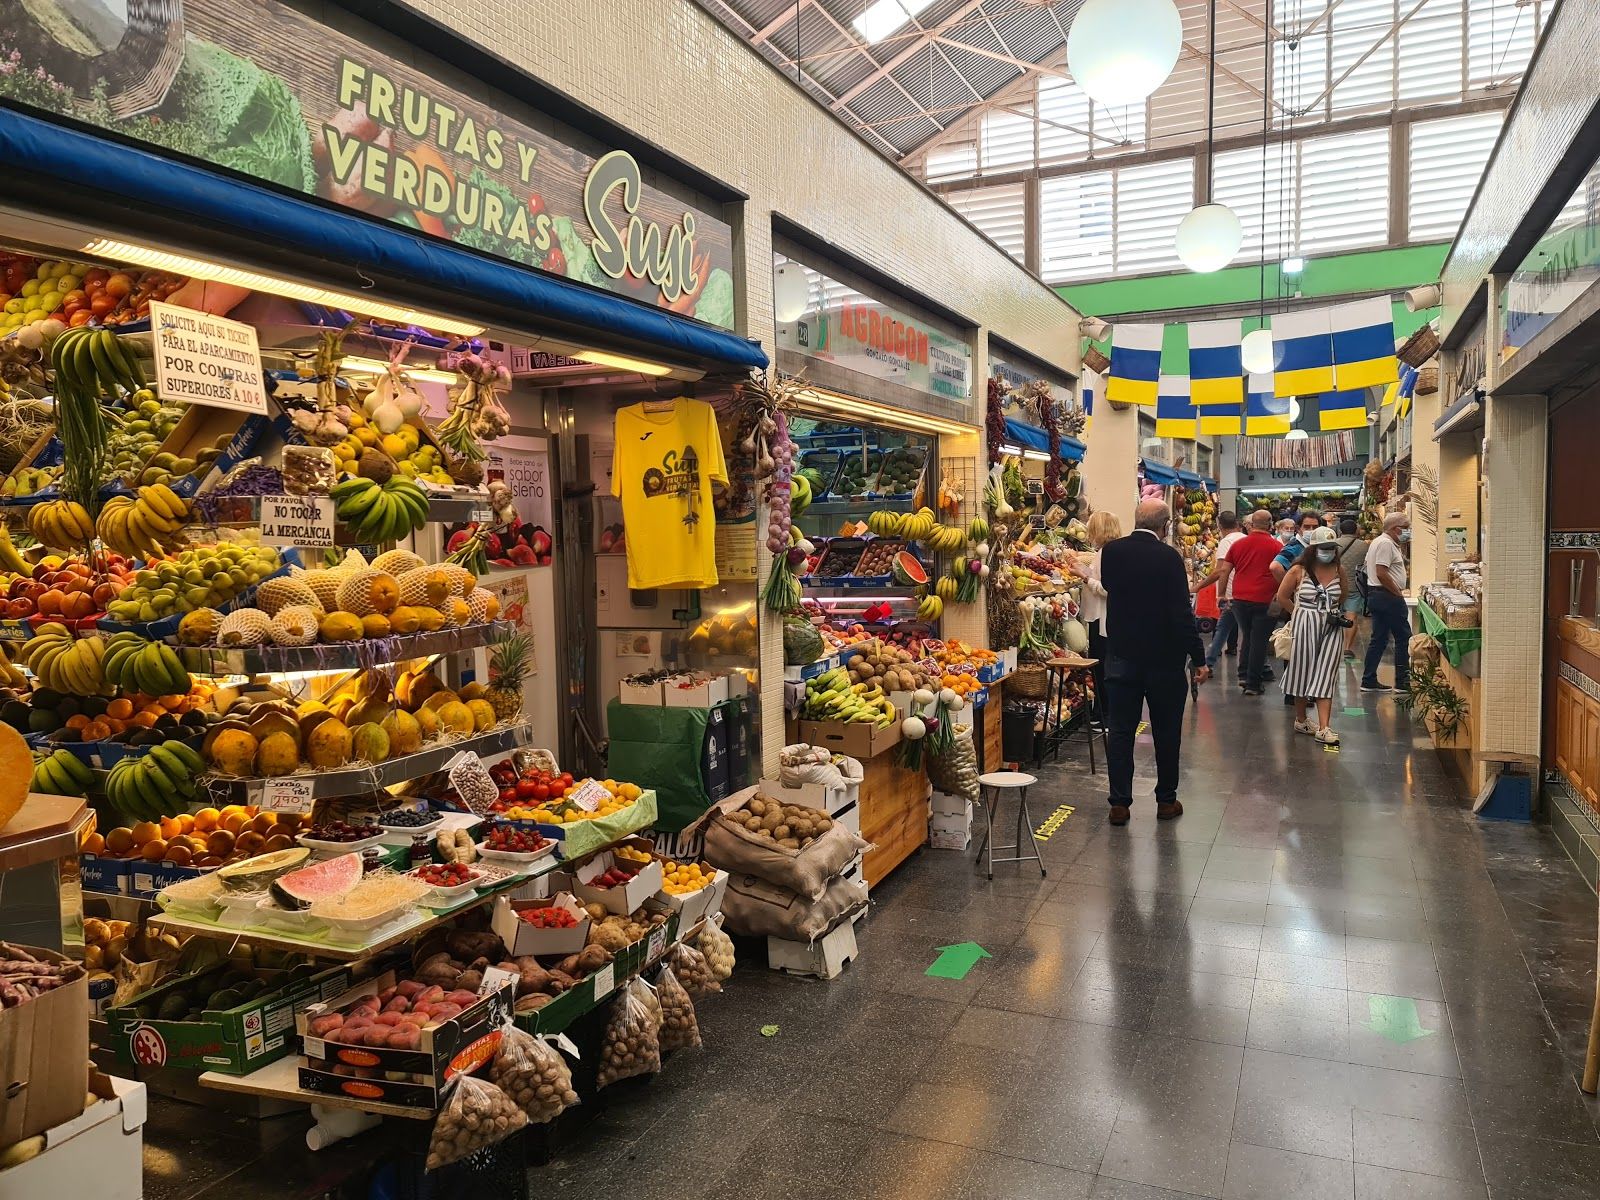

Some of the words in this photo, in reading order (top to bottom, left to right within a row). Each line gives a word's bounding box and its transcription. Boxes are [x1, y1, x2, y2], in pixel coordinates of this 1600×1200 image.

[338, 57, 505, 171] FRUTAS
[516, 140, 538, 184] Y
[323, 126, 553, 253] VERDURAS
[583, 149, 699, 303] Susi
[160, 312, 196, 332] SOLICITE
[198, 322, 216, 338] AQUI
[216, 325, 226, 339] SU
[227, 328, 250, 345] TICKET
[162, 334, 186, 351] PARA
[187, 339, 198, 353] EL
[200, 341, 255, 366] APARCAMIENTO
[164, 355, 195, 373] POR
[199, 362, 258, 386] COMPRAS
[166, 377, 232, 400] SUPERIORES
[234, 388, 241, 401] A
[241, 390, 253, 404] 10
[509, 465, 544, 482] sabor
[1271, 469, 1309, 480] LOLITA
[1319, 469, 1325, 478] E
[274, 505, 288, 518] NO
[290, 506, 322, 520] TOCAR
[262, 524, 274, 537] LA
[277, 524, 331, 539] MERCANCIA
[293, 539, 333, 547] GRACIAS
[461, 1035, 491, 1058] FRUTAS
